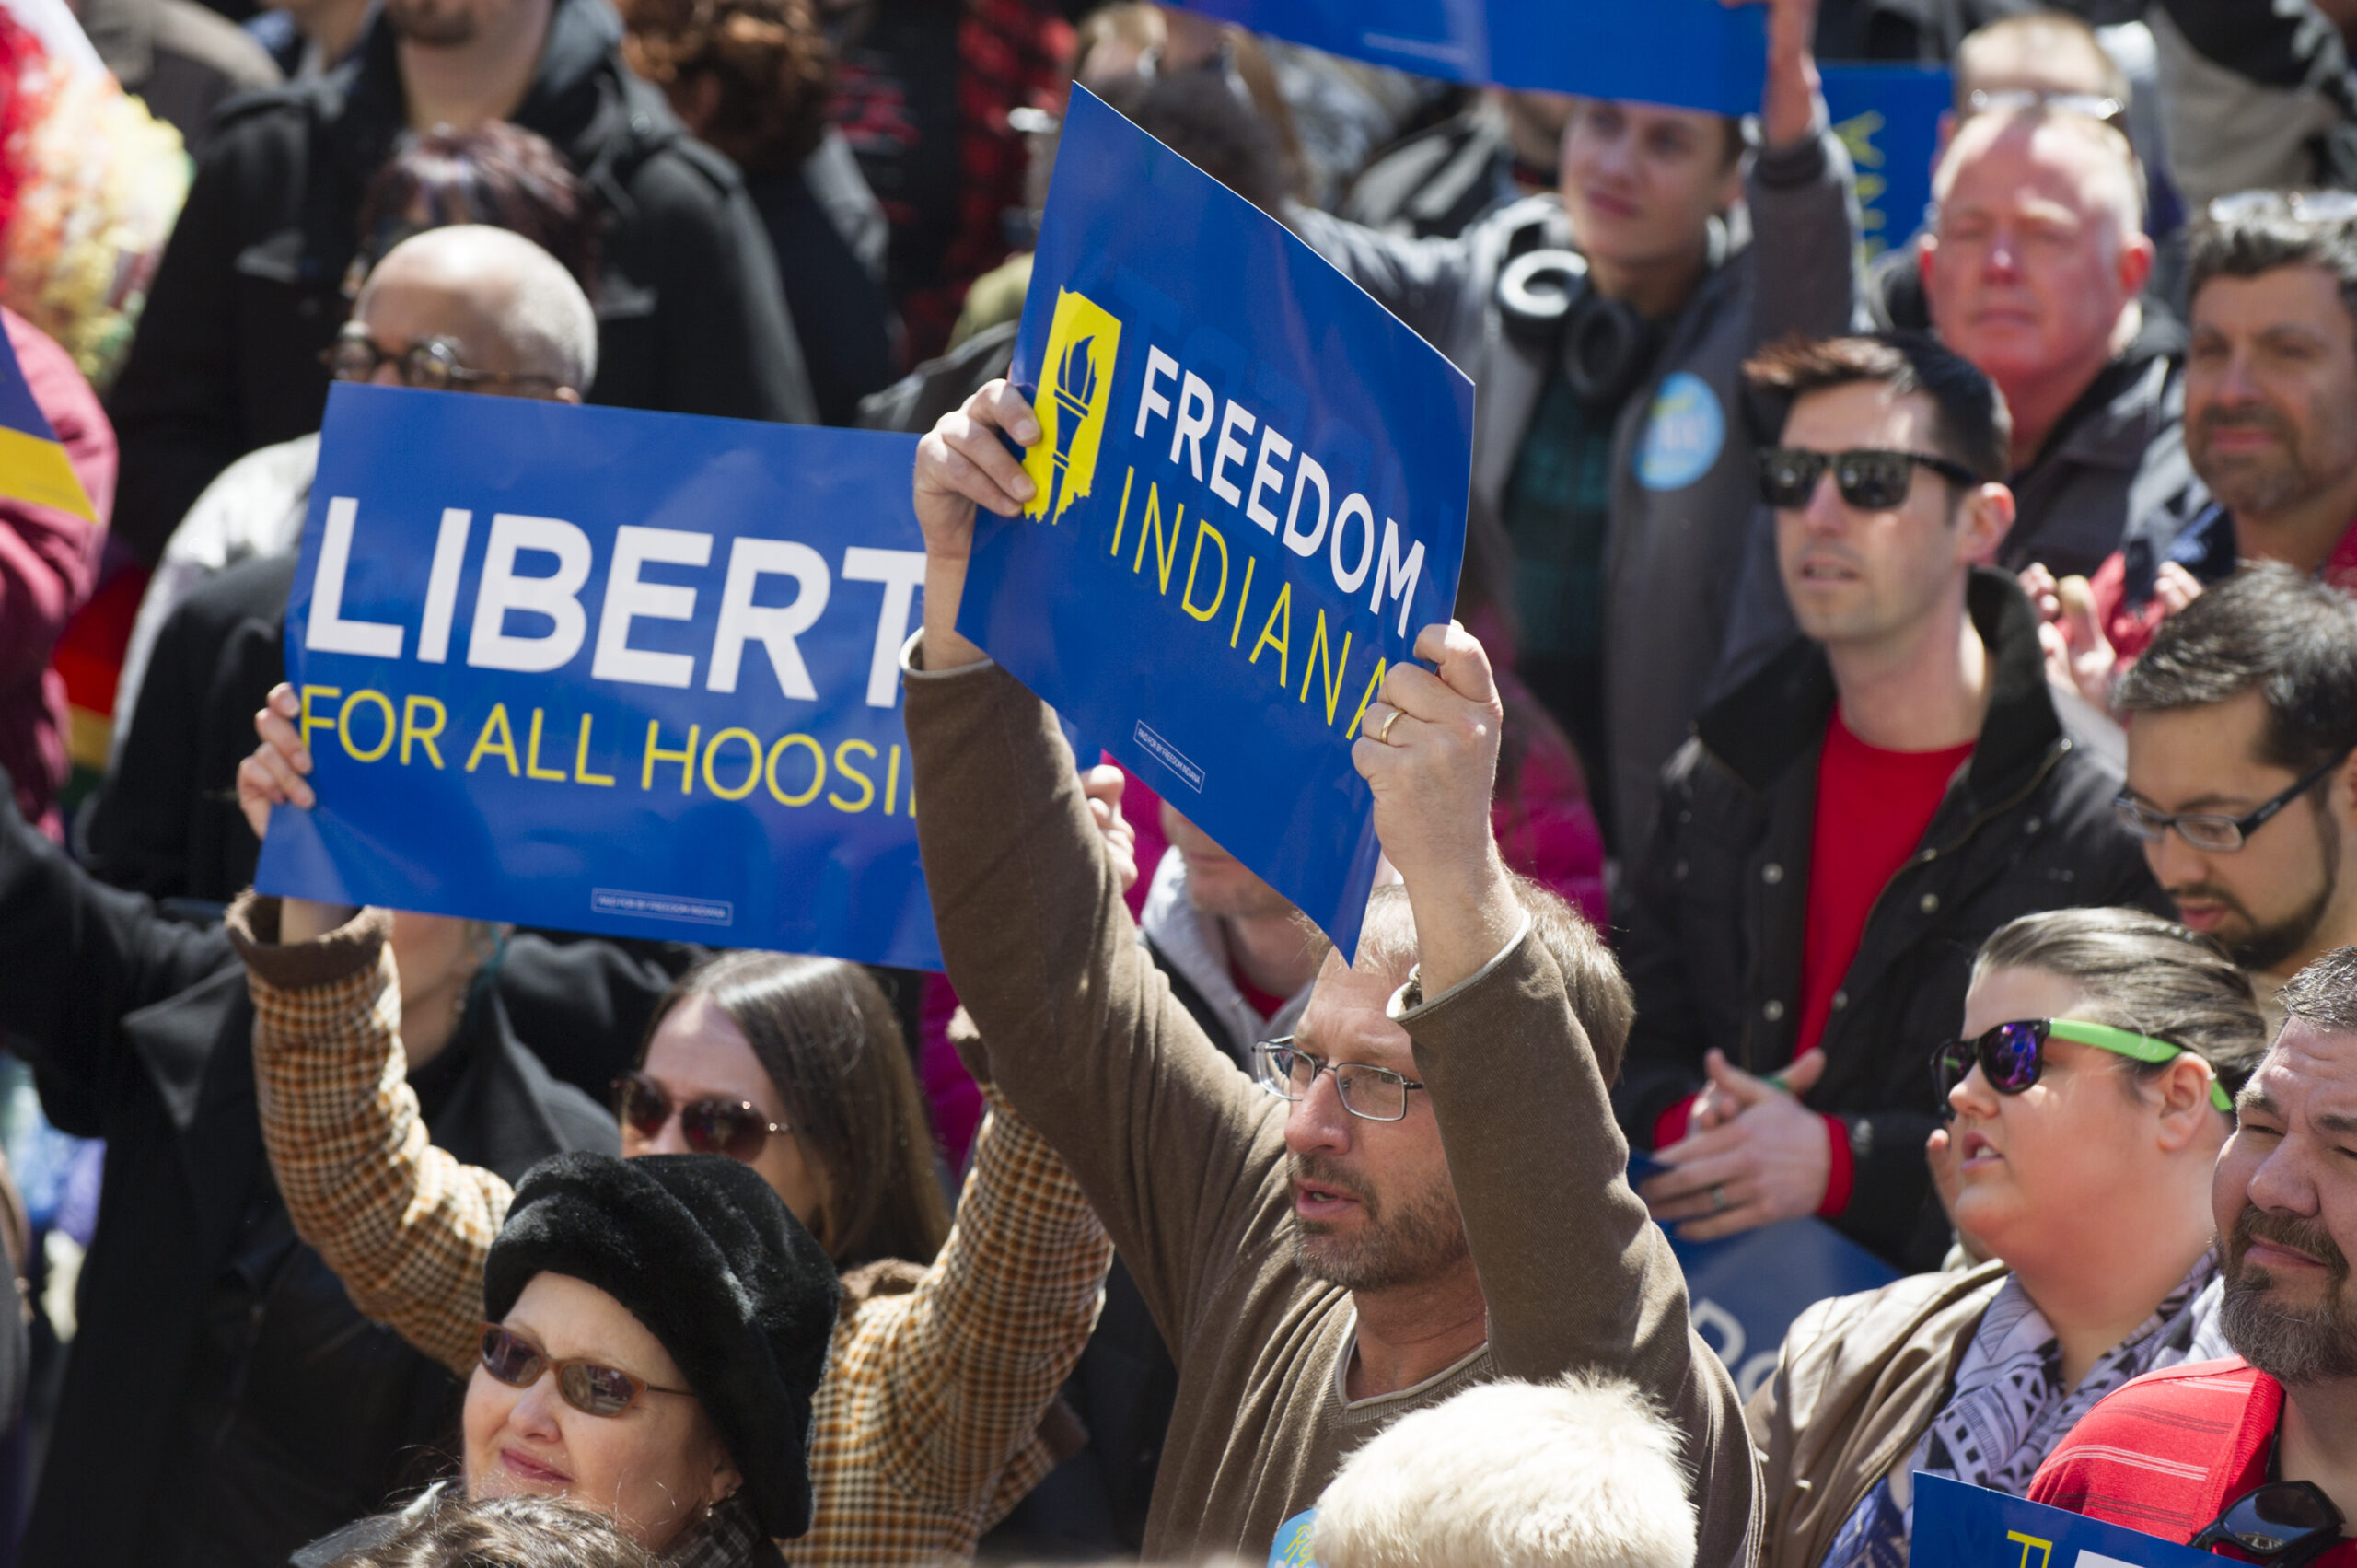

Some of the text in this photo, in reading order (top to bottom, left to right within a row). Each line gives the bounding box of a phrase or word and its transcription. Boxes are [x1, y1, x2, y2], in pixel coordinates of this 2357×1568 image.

[1134, 344, 1425, 639] FREEDOM
[300, 684, 917, 818] FOR ALL HOOSI
